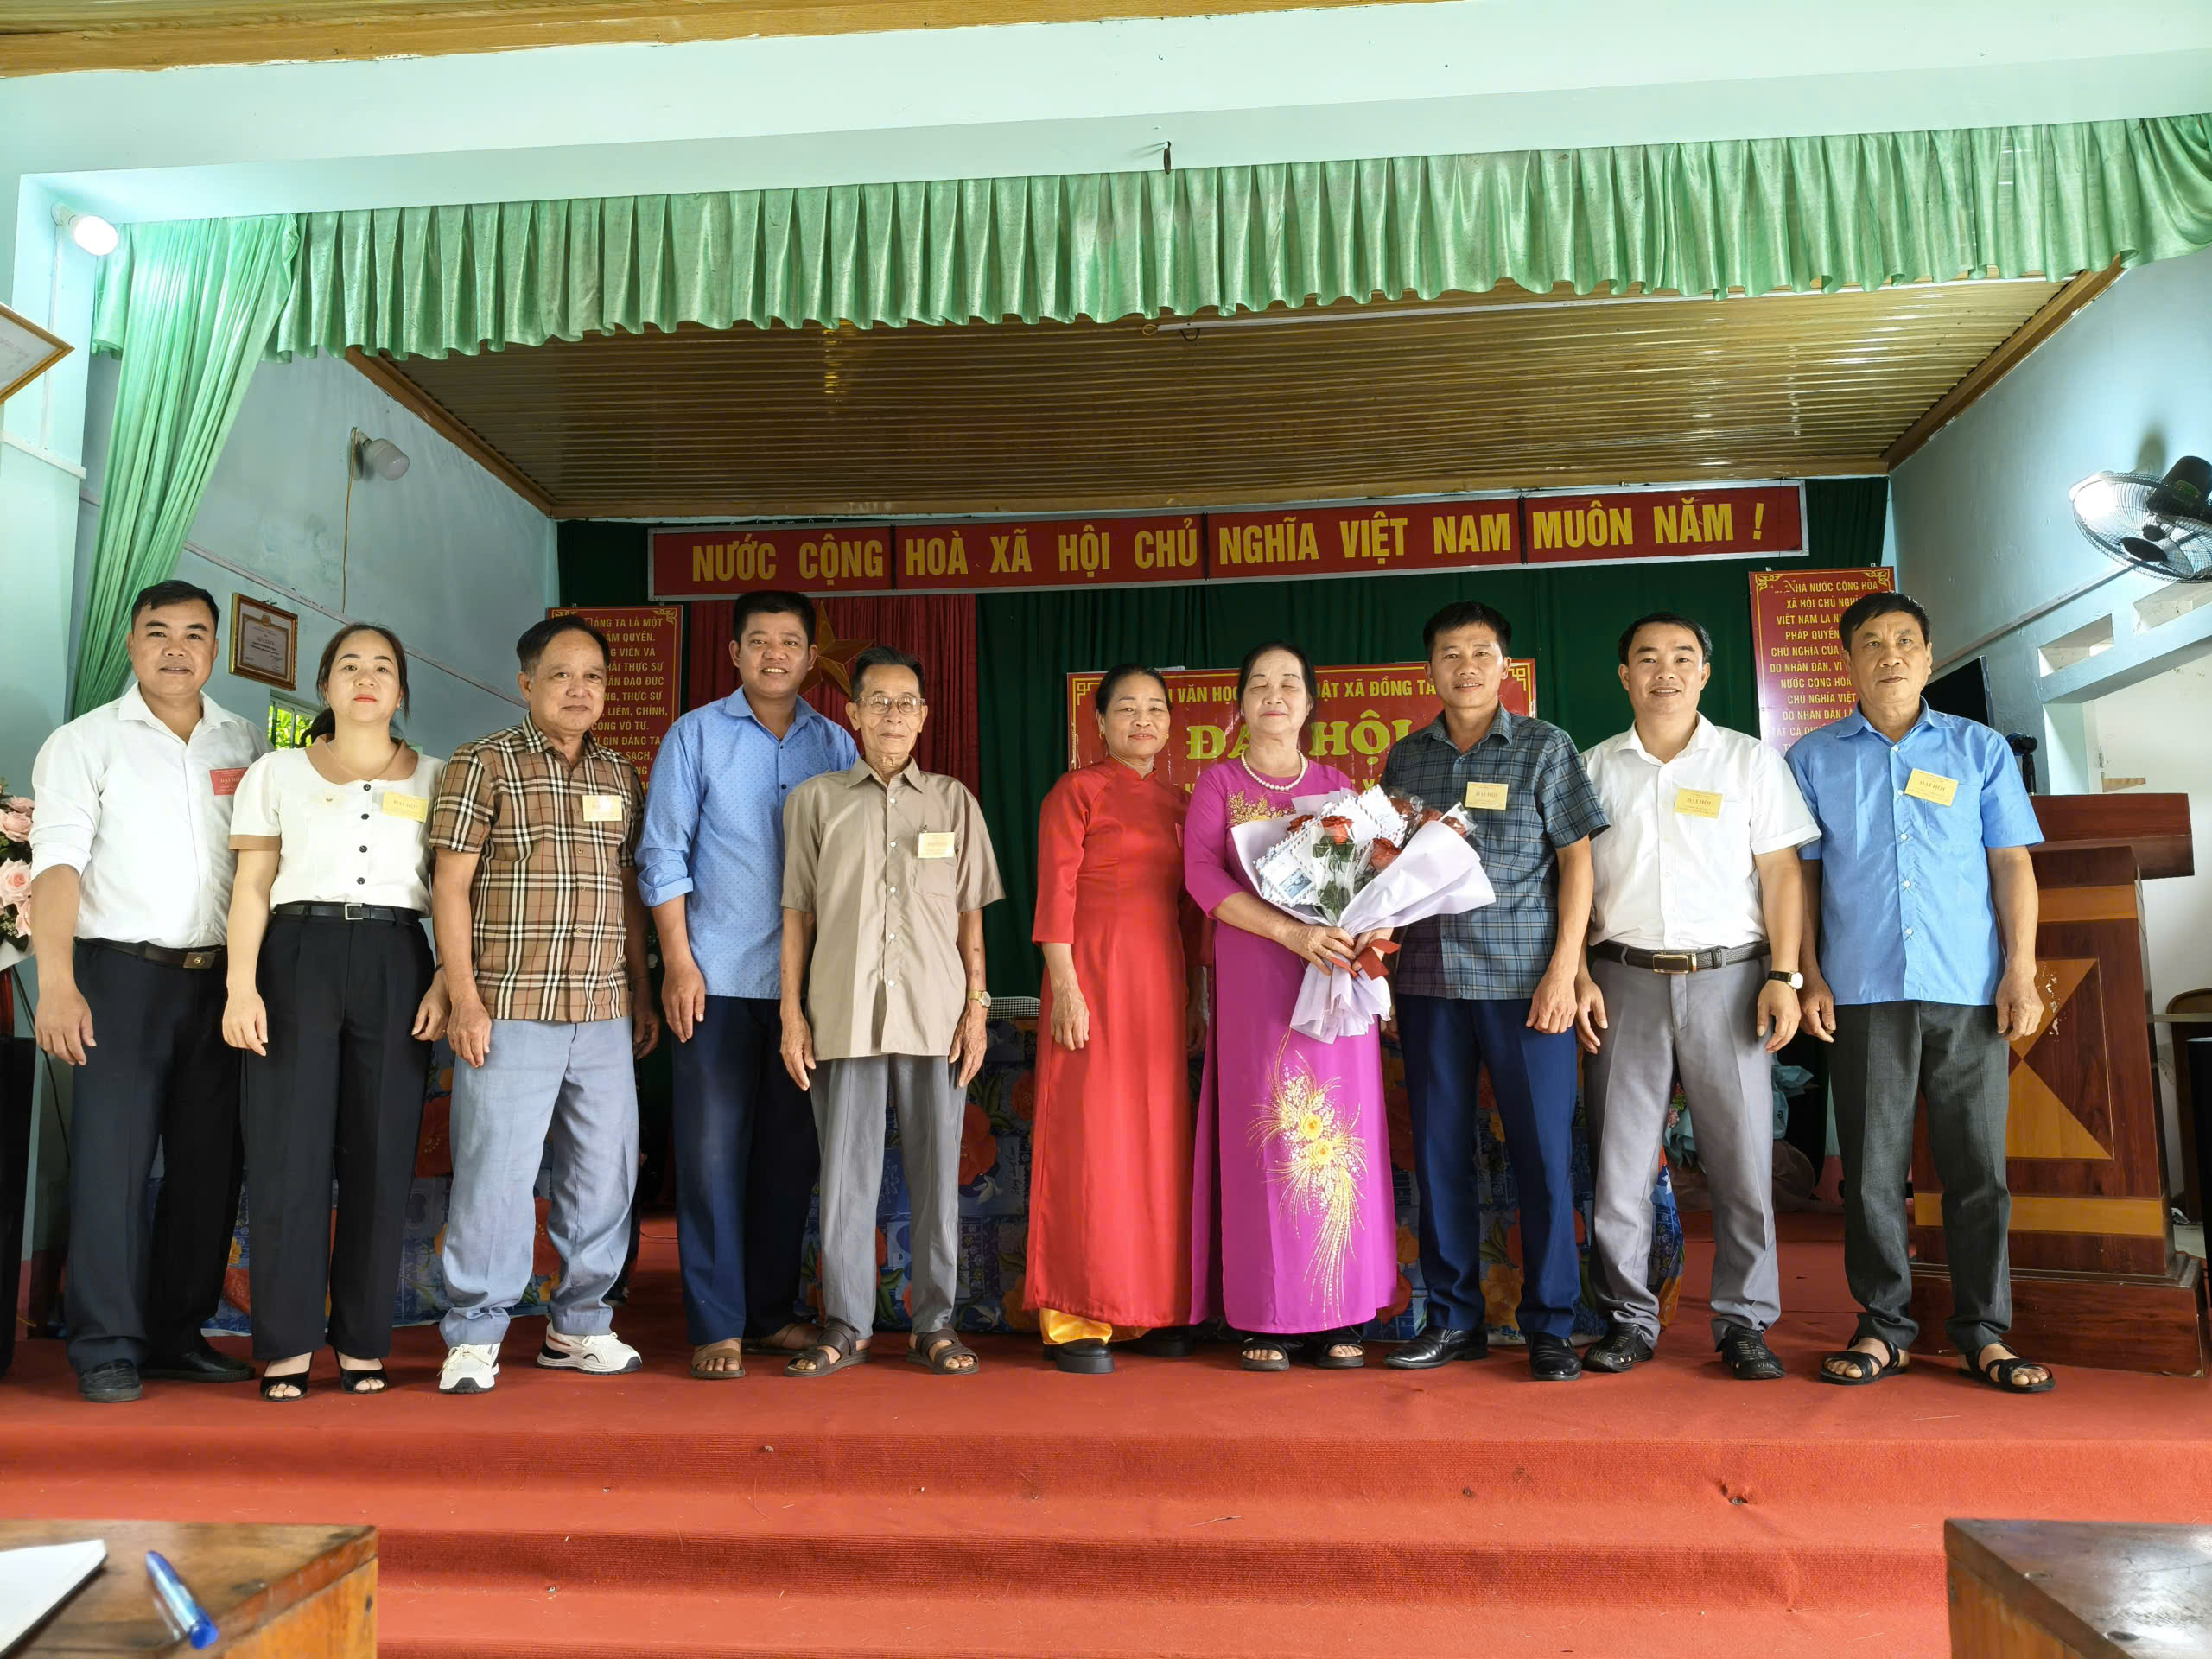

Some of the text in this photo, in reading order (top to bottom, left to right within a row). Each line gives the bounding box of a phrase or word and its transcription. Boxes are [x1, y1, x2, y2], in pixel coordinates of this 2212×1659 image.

[691, 496, 1765, 586] NƯỚC CỘNG HOÀ XÃ HỘI CHỦ NGHĨA VIỆT NAM MUÔN NĂM !
[1836, 579, 1859, 593] CỘNG
[1786, 597, 1798, 608] XÃ
[1800, 596, 1815, 609] HỘI
[1818, 595, 1836, 607] CHỦ
[615, 619, 626, 627] TA
[629, 615, 640, 627] LÀ
[642, 615, 663, 629] MỘT
[1777, 613, 1796, 626] VIỆT
[1798, 614, 1817, 624] NAM
[1821, 612, 1831, 623] LÀ
[1785, 629, 1808, 640] PHÁP
[620, 646, 640, 657] VIÊN
[644, 645, 656, 657] VÀ
[1770, 643, 1840, 657] CHỦ NGHĨA CỦA
[623, 661, 648, 673] THỰC
[651, 661, 664, 673] SỰ
[1770, 663, 1782, 672] DO
[1784, 660, 1808, 672] NHÂN
[623, 677, 642, 688] ĐẠO
[1177, 683, 1208, 703] VĂN
[1344, 678, 1365, 698] XÃ
[1370, 675, 1413, 697] ĐỒNG
[1808, 676, 1832, 689] CỘNG
[622, 690, 647, 703] THỰC
[650, 690, 663, 702] SỰ
[1787, 691, 1857, 704] CHỦ NGHĨA VIỆT
[1797, 709, 1821, 720] NHÂN
[1824, 708, 1841, 719] DÂN
[591, 720, 616, 731] CÔNG
[619, 720, 632, 731] VÔ
[621, 734, 646, 746] ĐẢNG
[650, 736, 661, 746] TA
